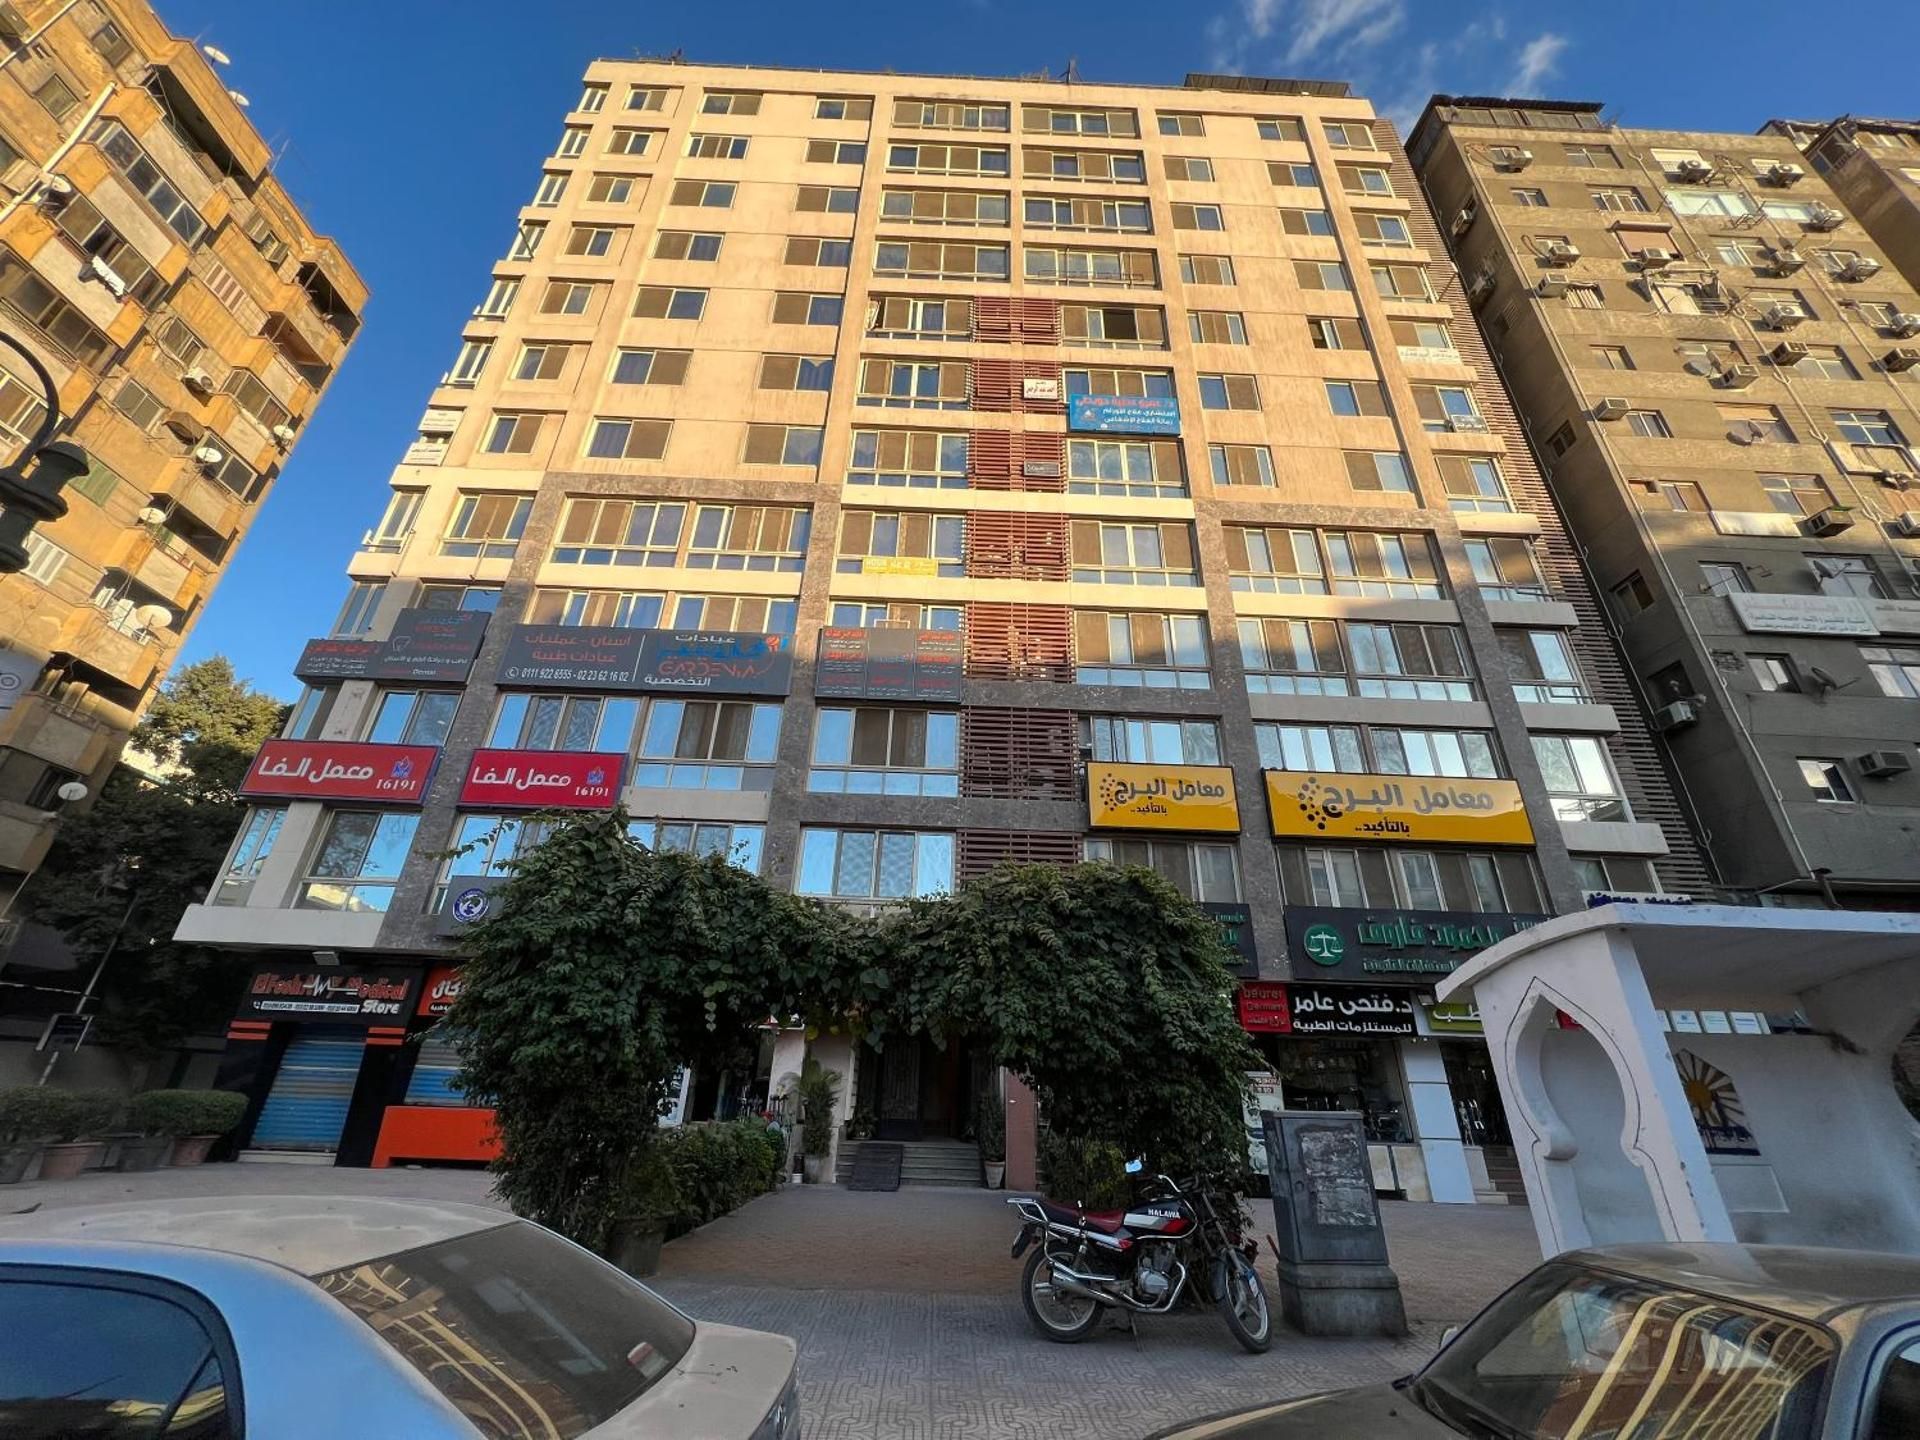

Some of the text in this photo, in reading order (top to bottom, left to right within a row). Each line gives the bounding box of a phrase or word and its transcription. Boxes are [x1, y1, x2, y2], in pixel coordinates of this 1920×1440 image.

[675, 634, 736, 644] عيادات
[644, 674, 711, 686] التخصصية
[257, 755, 374, 783] معمل الفا
[376, 779, 417, 791] 16191
[471, 766, 572, 791] معمل الفا
[575, 786, 609, 797] 16191
[1114, 777, 1225, 805] معامل البرج
[1321, 782, 1495, 819] معامل البرج
[361, 999, 401, 1015] Store
[1294, 991, 1335, 1015] عامر
[1293, 1018, 1336, 1032] الطبية
[1337, 1019, 1412, 1034] للمستلزمات
